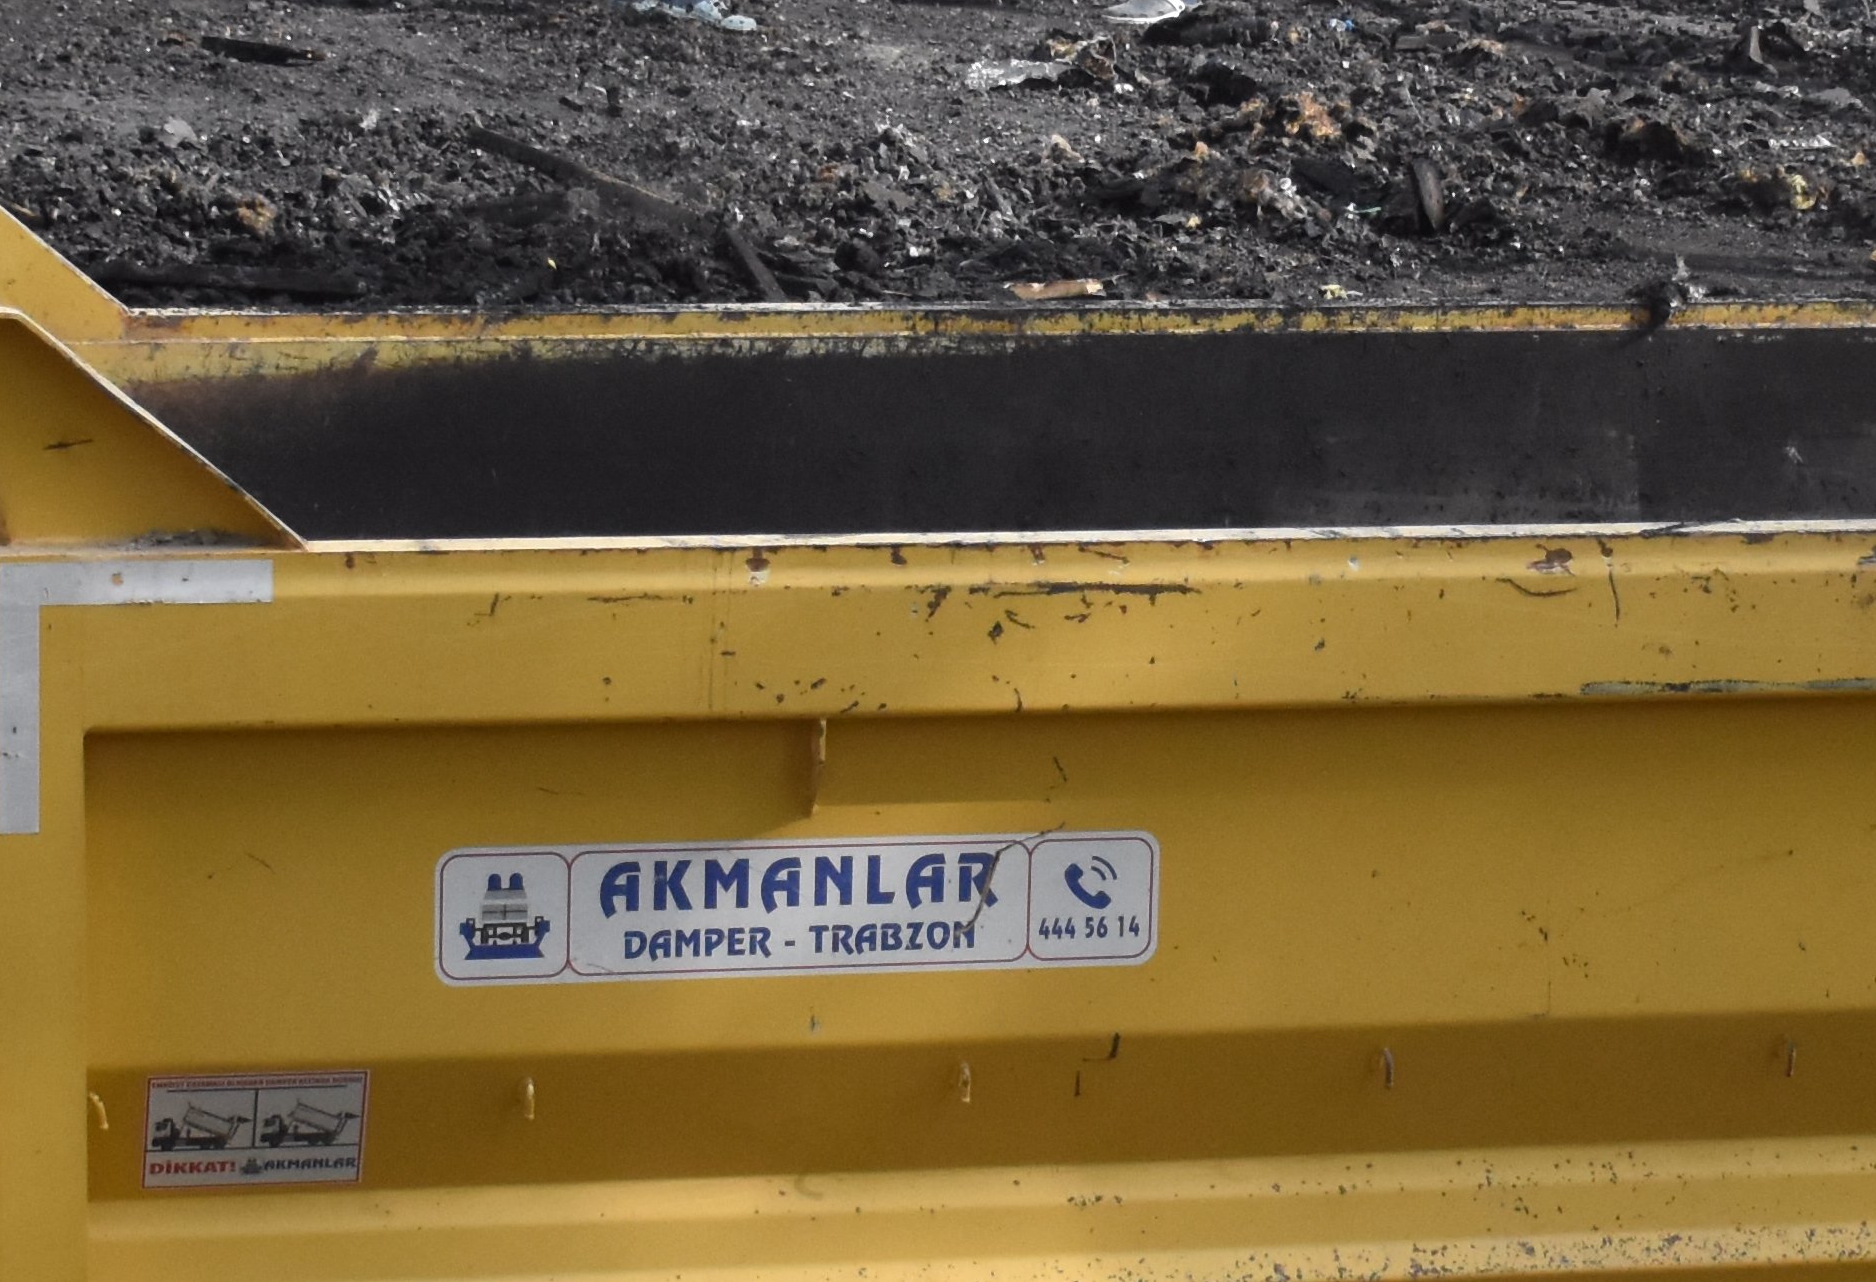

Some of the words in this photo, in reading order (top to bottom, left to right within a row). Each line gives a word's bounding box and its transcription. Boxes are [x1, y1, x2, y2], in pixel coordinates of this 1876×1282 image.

[599, 850, 1000, 919] AKMANLAR
[623, 927, 771, 961] DAMPER
[808, 920, 977, 956] TRABZON
[1037, 916, 1077, 942] 444
[1083, 915, 1110, 940] 56
[1116, 913, 1142, 939] 14
[263, 1156, 357, 1171] AKMANLAR
